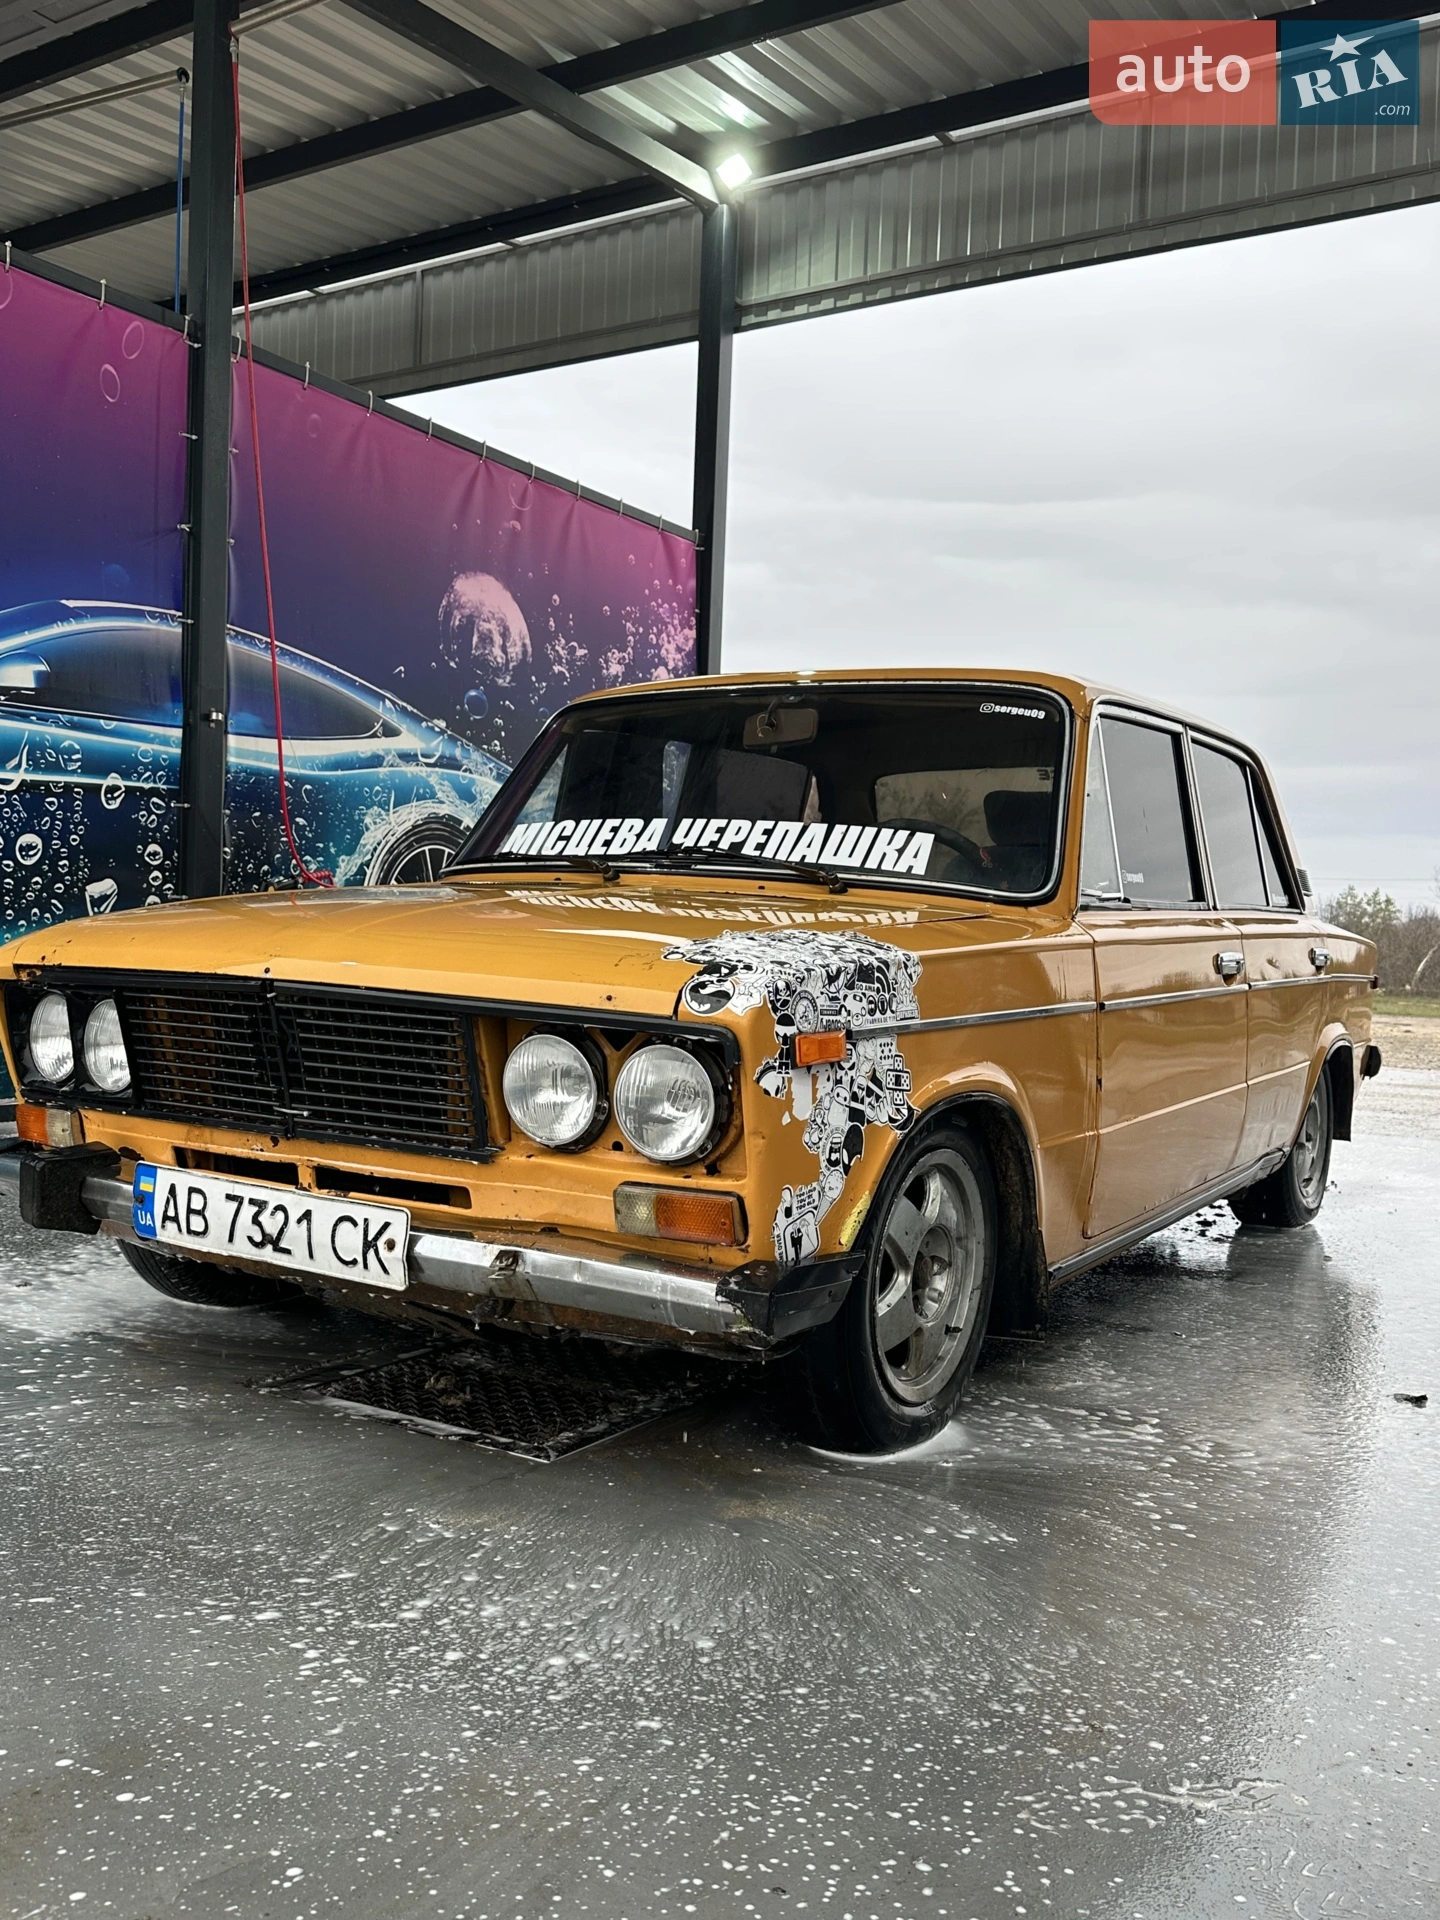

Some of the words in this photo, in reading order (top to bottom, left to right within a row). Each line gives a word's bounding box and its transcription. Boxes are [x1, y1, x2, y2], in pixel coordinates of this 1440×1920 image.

[502, 818, 668, 857] МІСЦЕВА
[672, 818, 937, 876] ЧЕРЕПАШКА
[138, 1210, 154, 1227] UA
[161, 1183, 209, 1238] AB
[225, 1193, 315, 1260] 7321
[330, 1215, 392, 1275] CK
